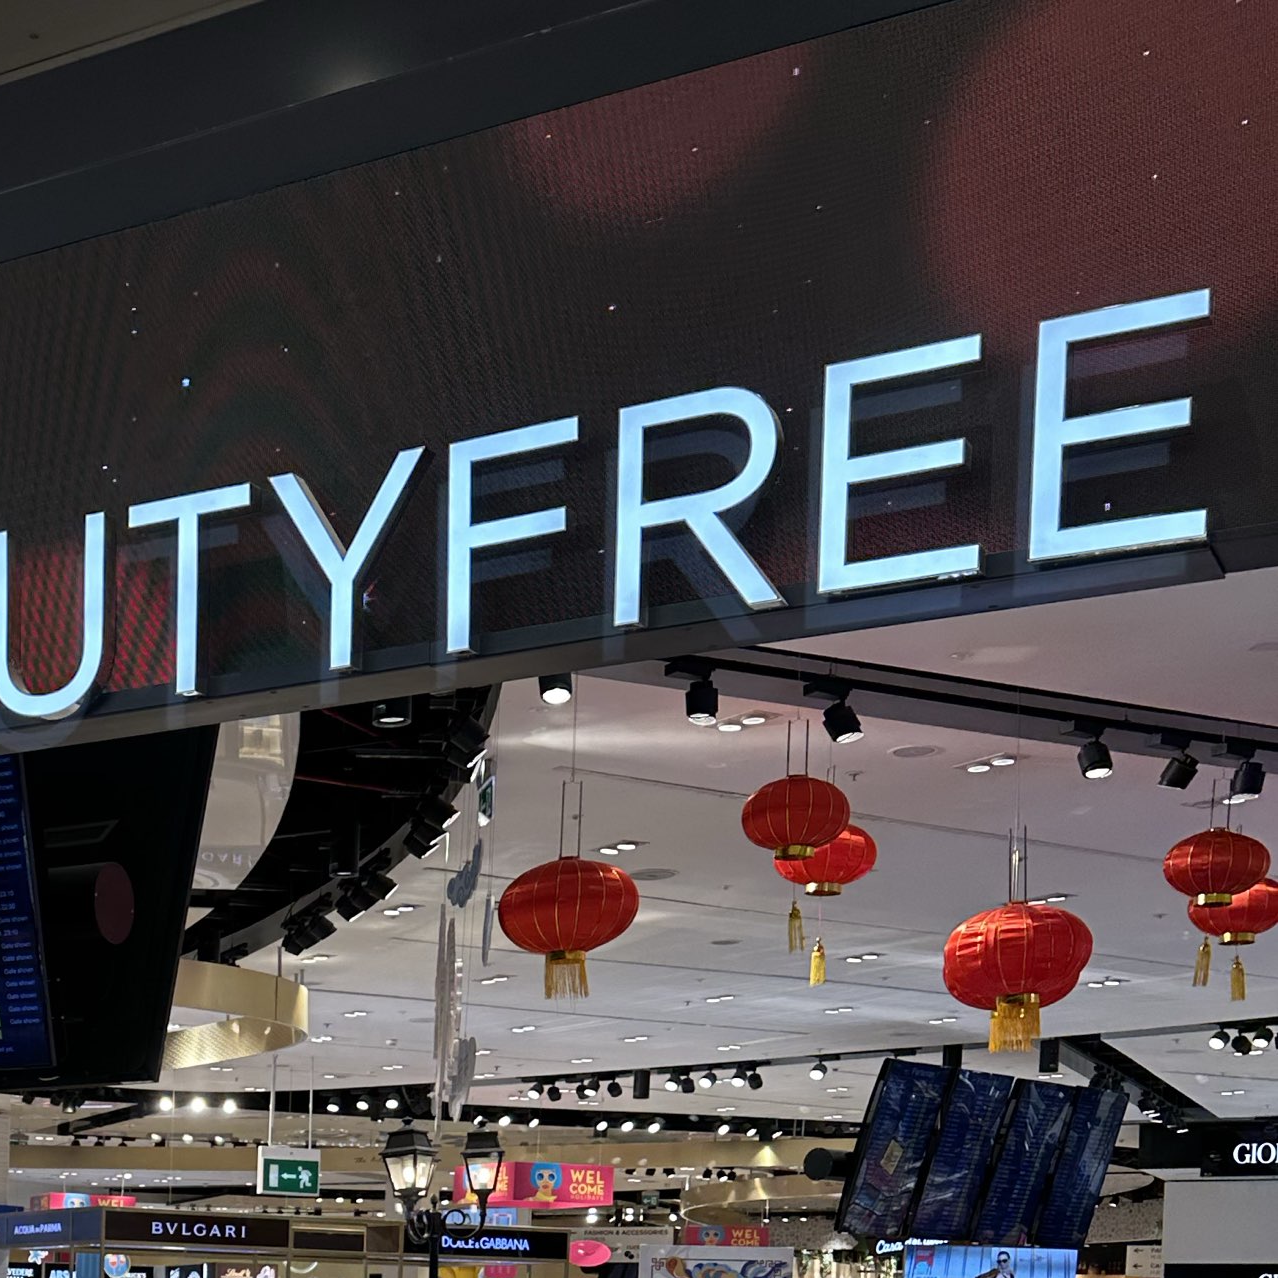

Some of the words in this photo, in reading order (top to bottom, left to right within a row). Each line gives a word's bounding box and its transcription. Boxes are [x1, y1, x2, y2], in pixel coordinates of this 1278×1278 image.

[570, 1169, 605, 1184] WEL
[568, 1184, 605, 1196] COME
[151, 1221, 247, 1239] BVLGARI
[731, 1229, 761, 1239] WEL
